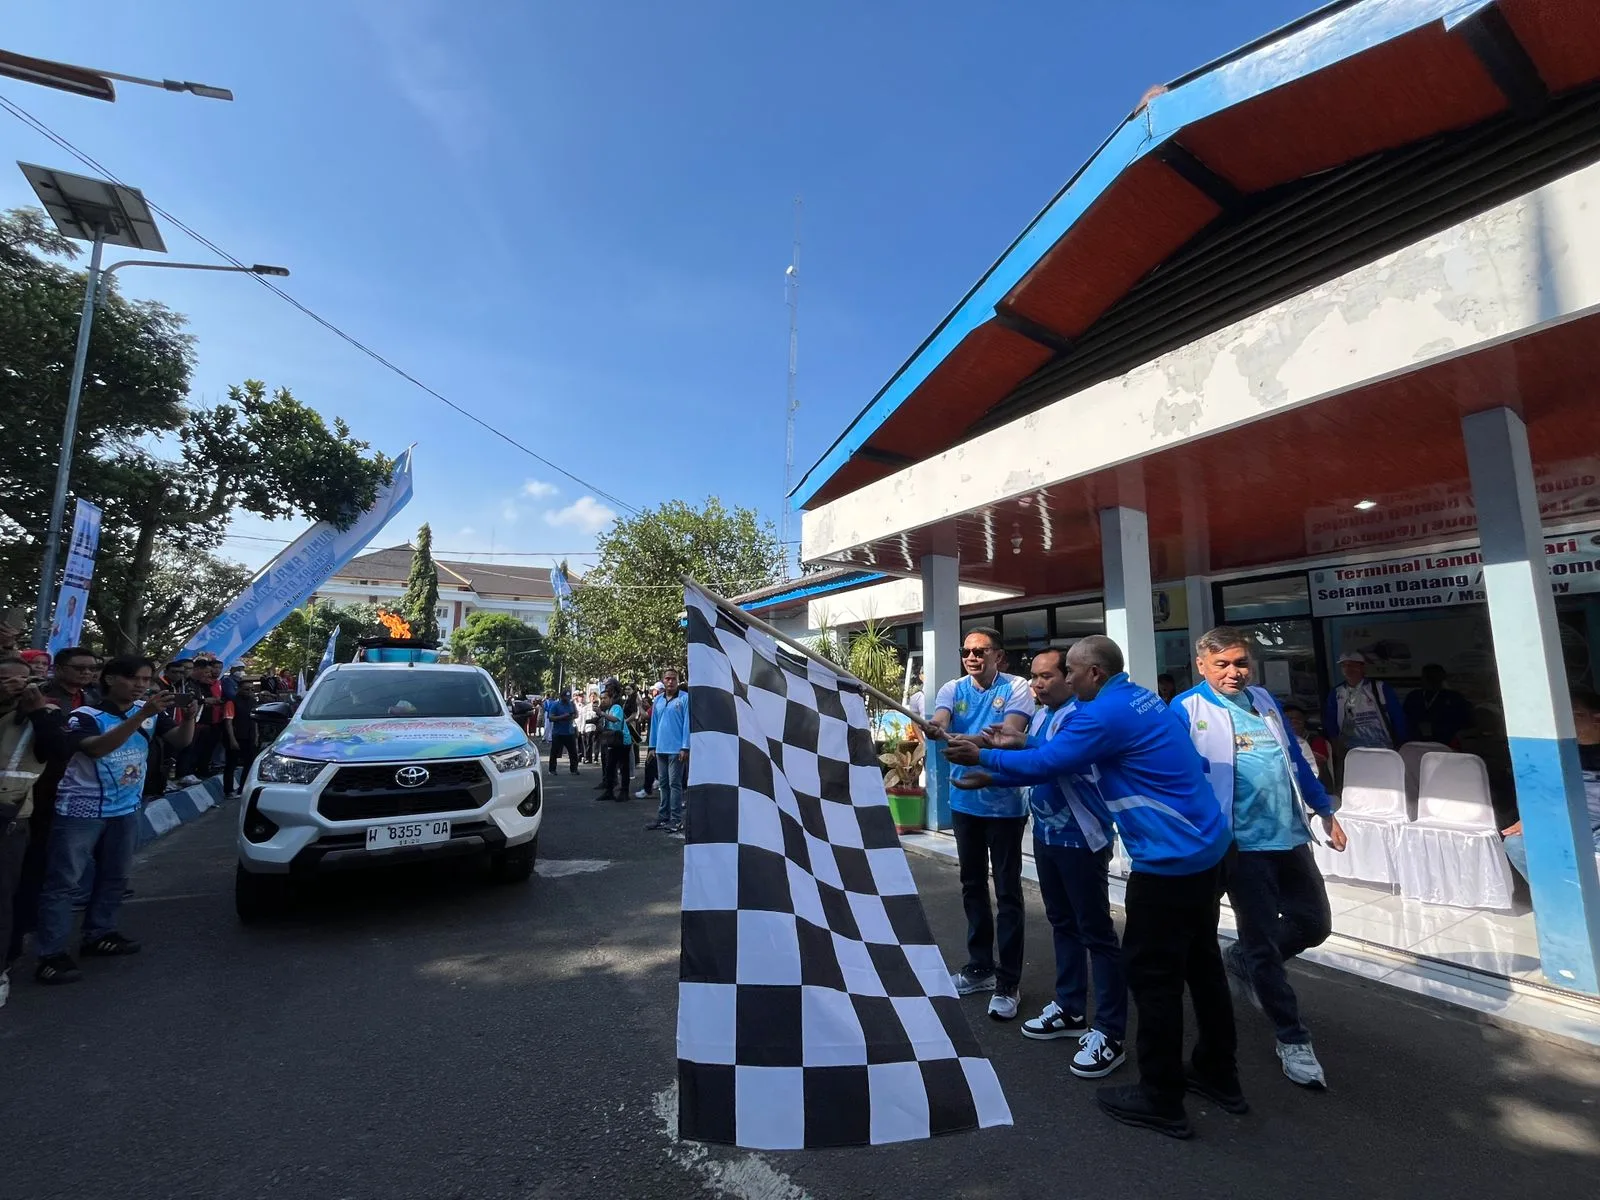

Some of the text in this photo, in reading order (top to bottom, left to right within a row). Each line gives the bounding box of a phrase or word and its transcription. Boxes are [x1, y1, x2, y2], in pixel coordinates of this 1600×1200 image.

[272, 556, 304, 583] JAWA
[302, 528, 335, 559] TIMUR
[273, 551, 331, 602] KOTA MALANG
[1334, 559, 1420, 581] Terminal
[1318, 578, 1391, 600] Selamat
[1396, 573, 1468, 592] Datang
[1346, 600, 1385, 612] Pintu
[1390, 593, 1442, 608] Utama
[369, 822, 448, 842] W 8355 QA
